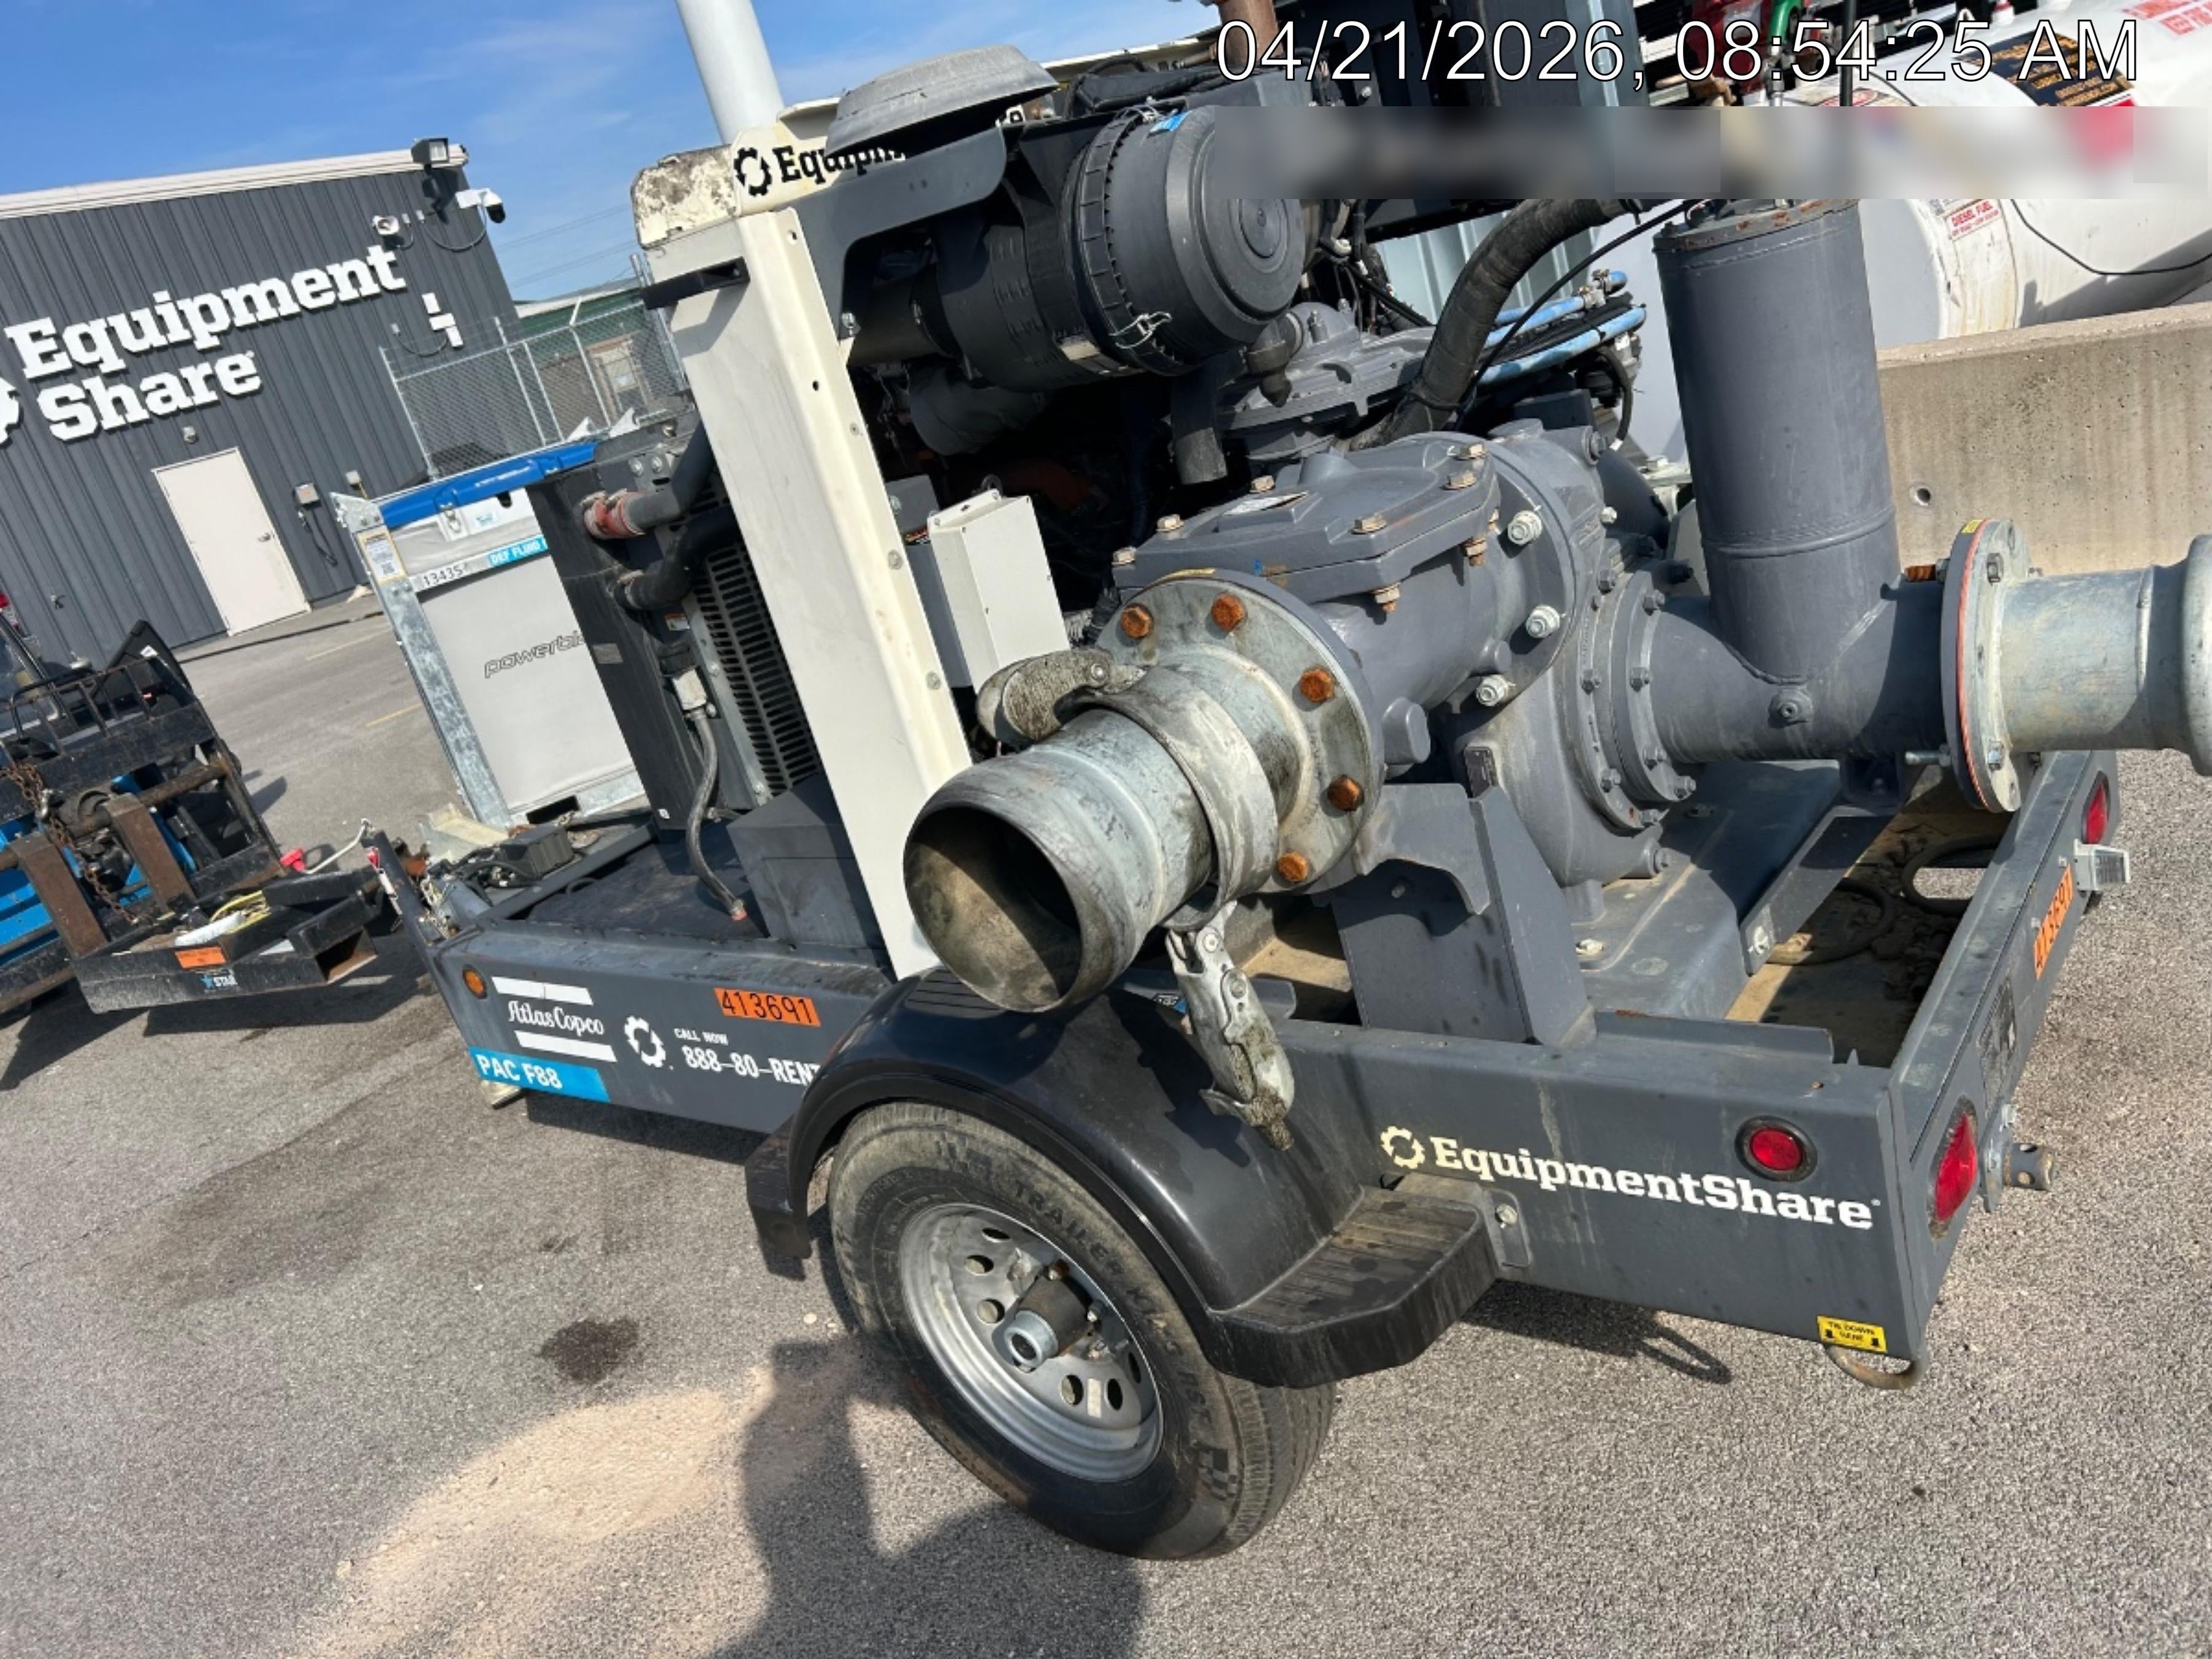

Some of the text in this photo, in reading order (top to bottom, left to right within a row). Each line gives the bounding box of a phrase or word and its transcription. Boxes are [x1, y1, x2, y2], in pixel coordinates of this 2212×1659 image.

[4, 245, 407, 379] Equipment
[37, 353, 262, 441] Share
[674, 1028, 729, 1046] CALL NOW
[722, 990, 812, 1024] 413691
[476, 1053, 563, 1089] PAC F88
[1429, 1136, 1875, 1230] EquipmentShare
